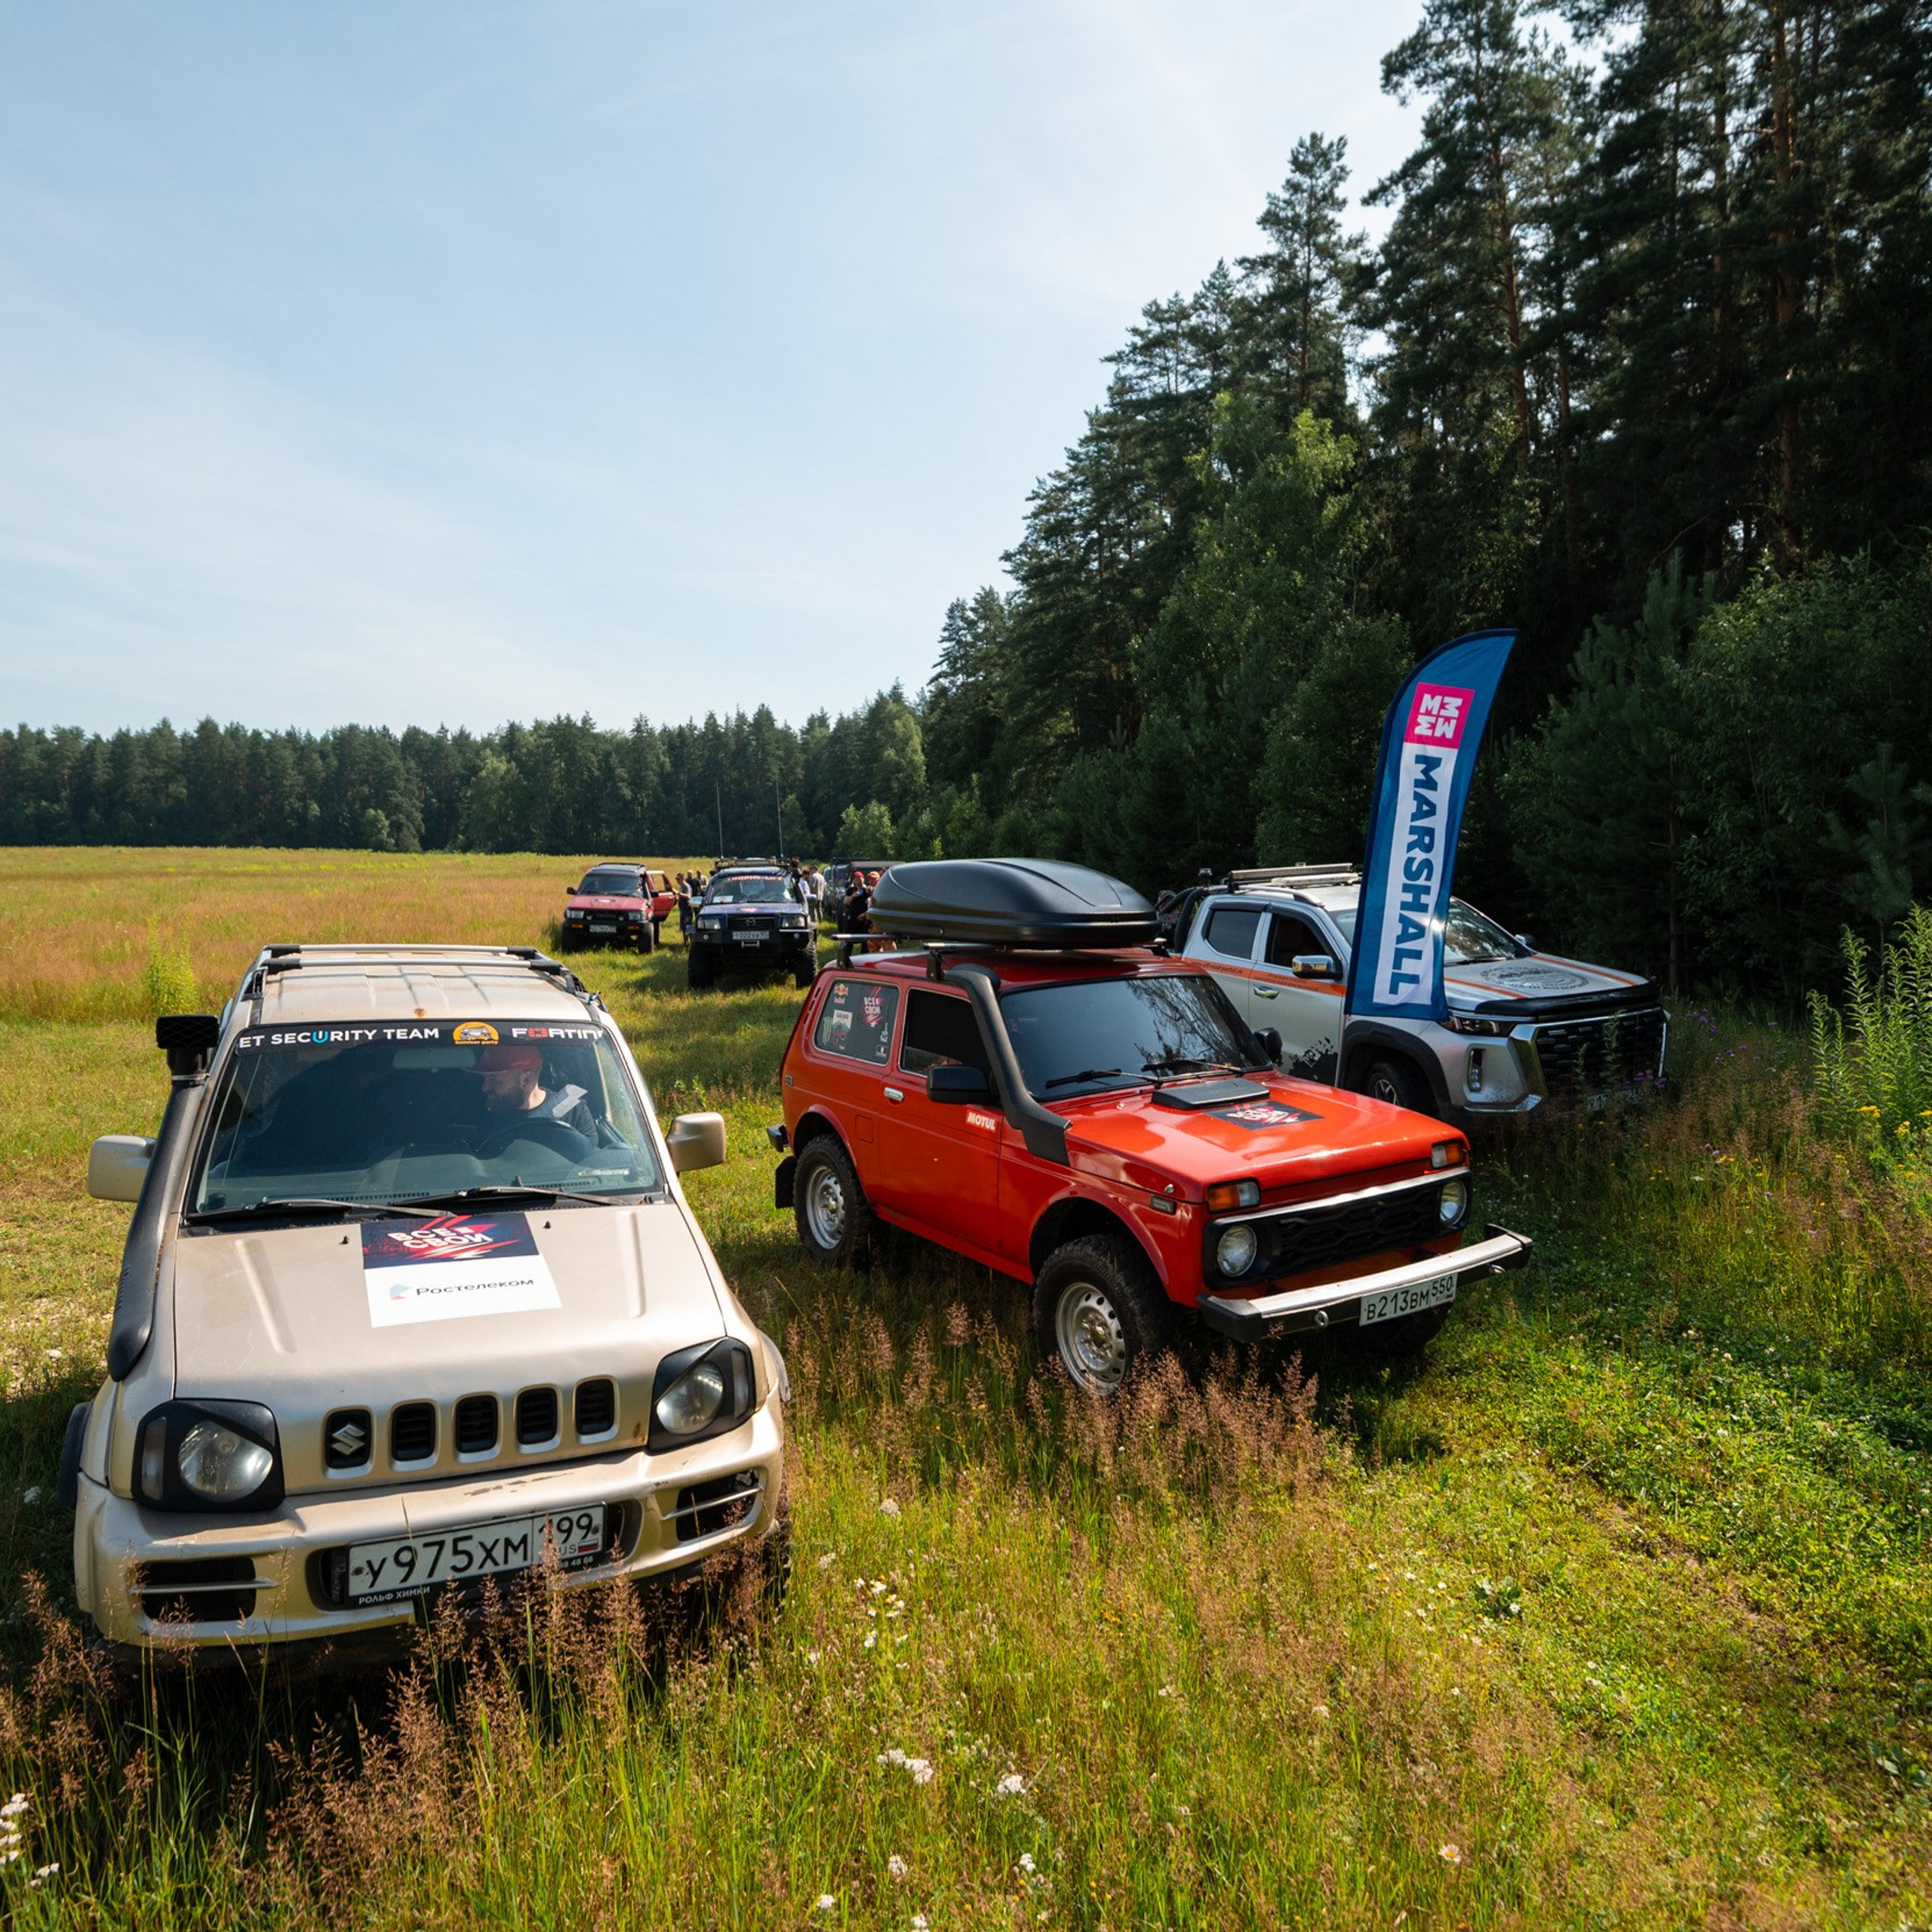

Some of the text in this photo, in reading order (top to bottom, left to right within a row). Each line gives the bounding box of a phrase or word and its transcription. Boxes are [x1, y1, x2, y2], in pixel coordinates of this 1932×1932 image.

[1389, 754, 1442, 995] MARSHALL
[270, 1029, 377, 1045] SECURITY
[383, 1028, 440, 1040] TEAM
[967, 1112, 995, 1131] MOTUL
[387, 1228, 457, 1242] ВСЕ
[402, 1233, 494, 1249] СВОИ
[416, 1279, 534, 1296] Ростелеком
[1367, 1275, 1454, 1321] В213ВМ 550
[366, 1533, 528, 1589] У975ХМ
[358, 1586, 431, 1605] РОЛЬФ ХИМКИ
